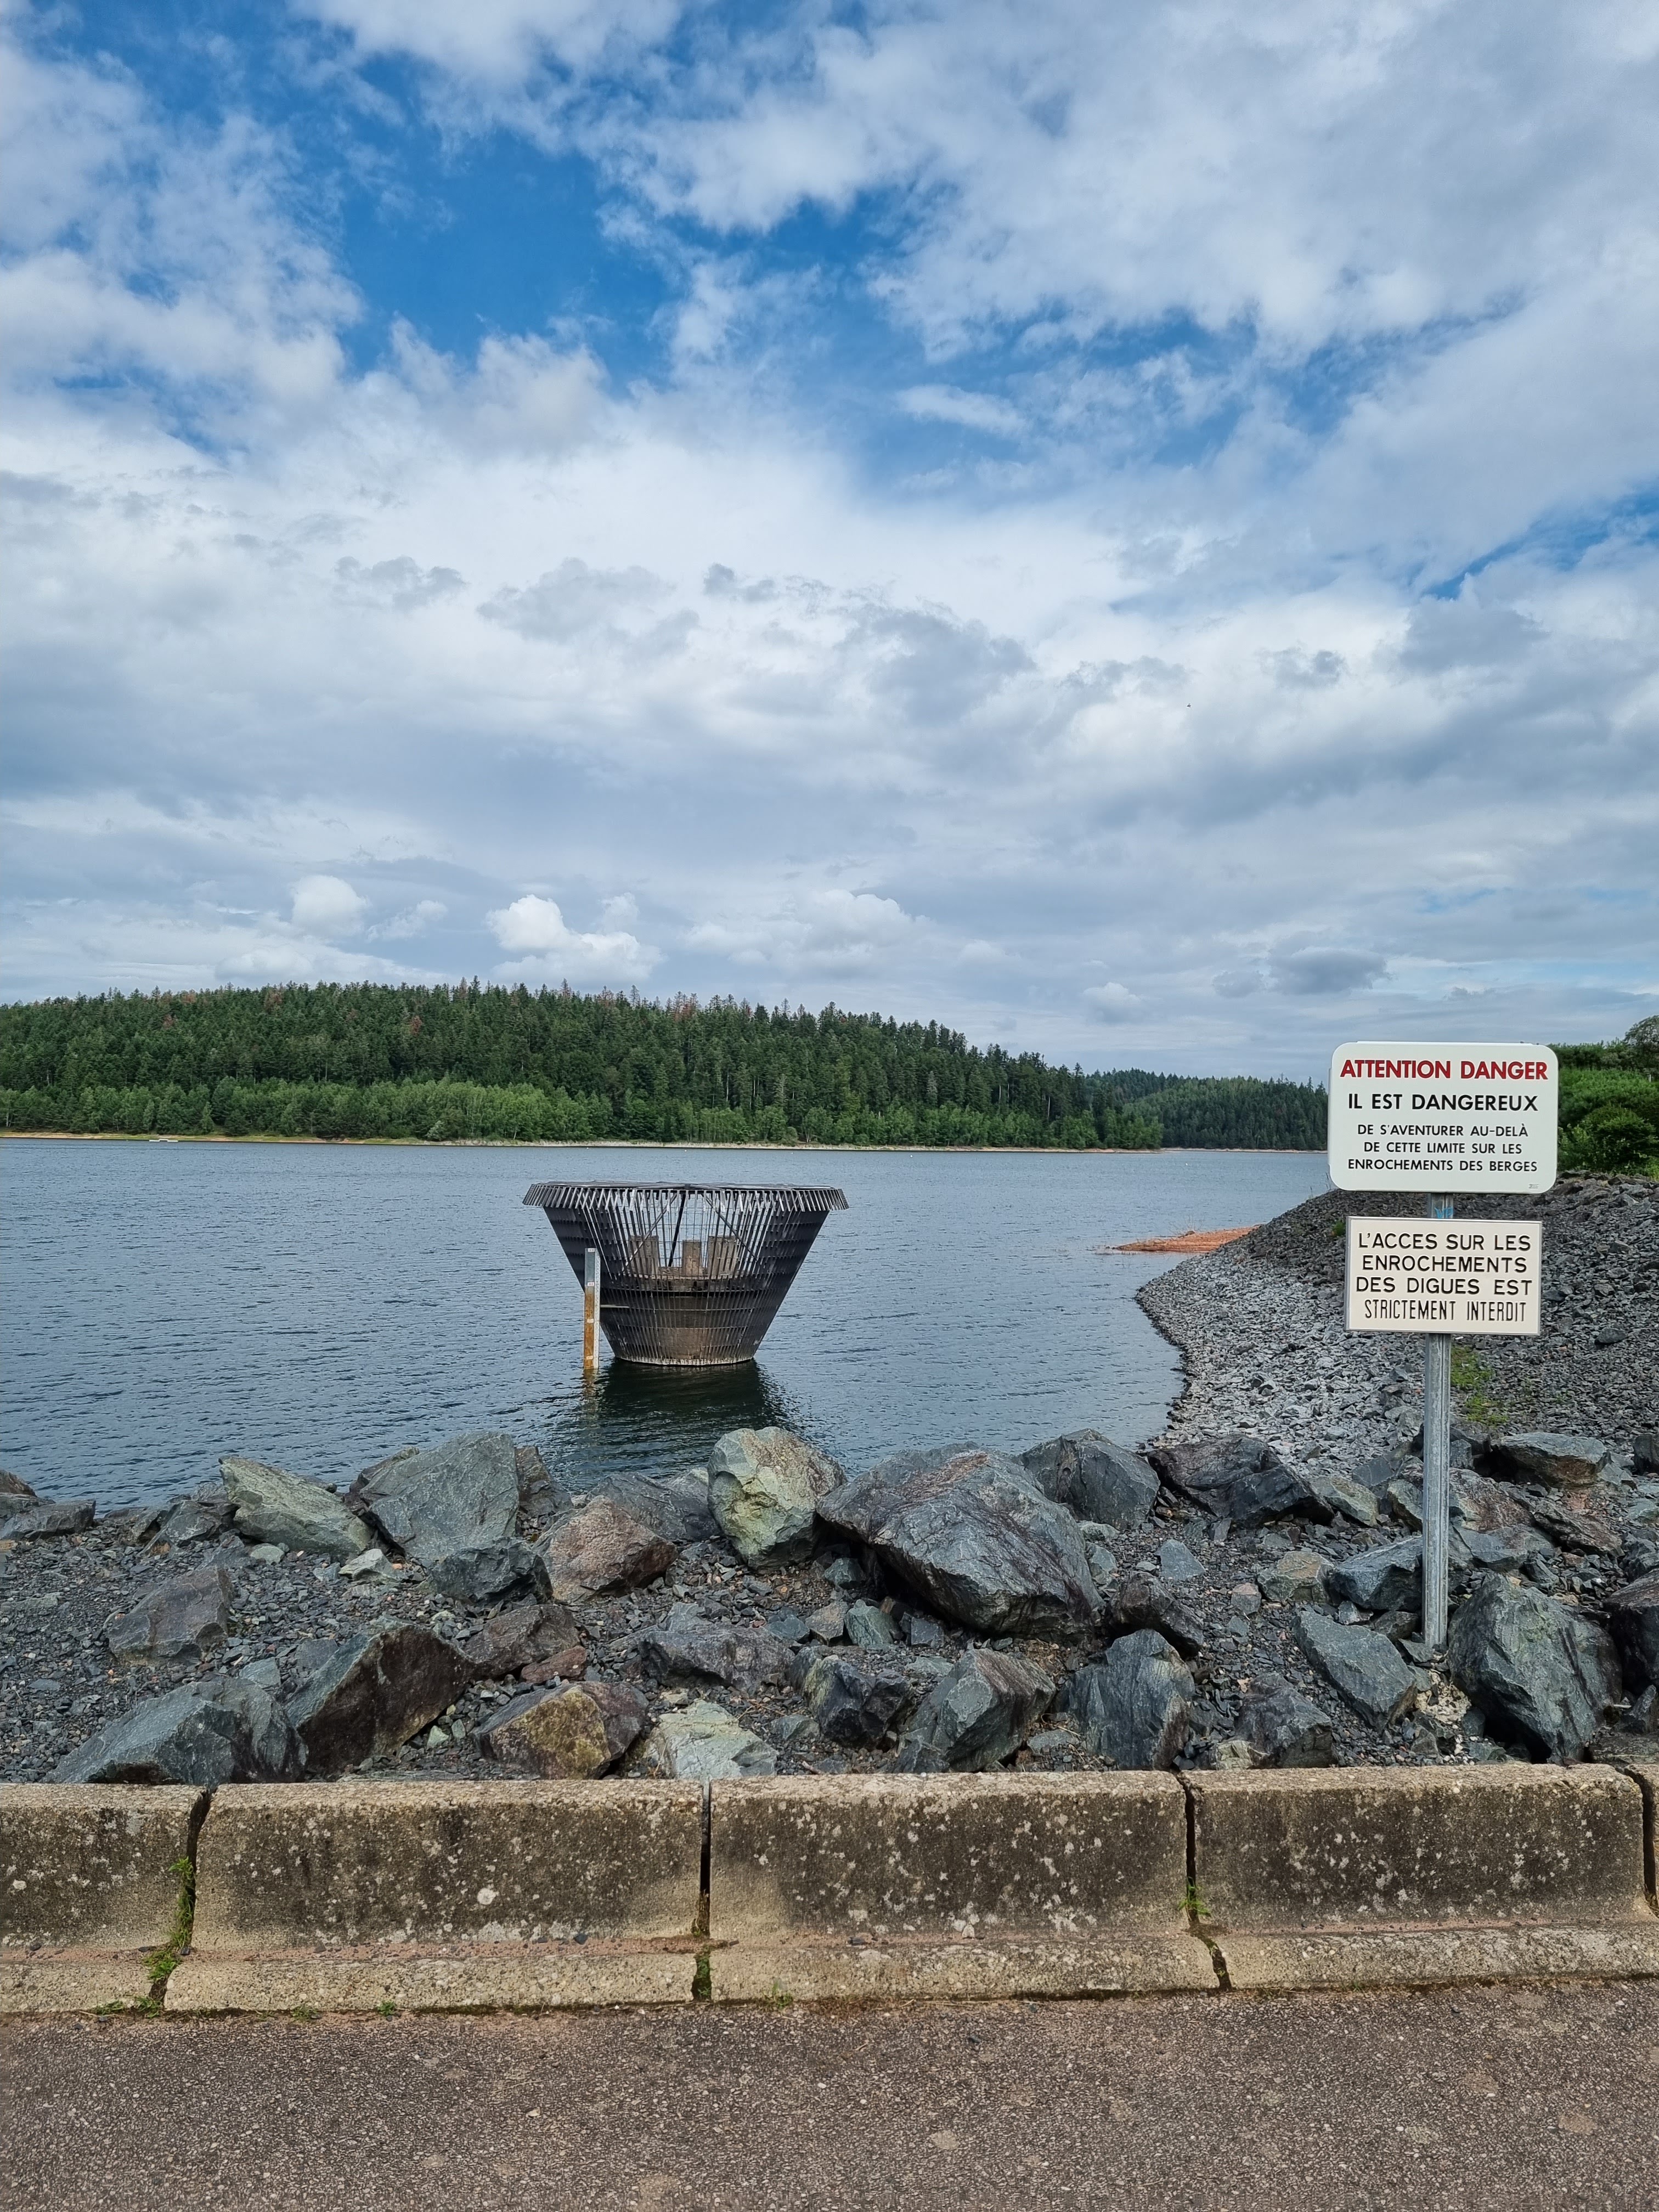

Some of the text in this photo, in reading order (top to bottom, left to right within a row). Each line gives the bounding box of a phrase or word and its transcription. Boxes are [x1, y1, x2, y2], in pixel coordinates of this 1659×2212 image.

[1340, 1060, 1548, 1080] ATTENTION DANGER
[1349, 1094, 1538, 1111] IL EST DANGEREUX
[1358, 1124, 1528, 1136] DE S'AVENTURER AU-DELÀ
[1364, 1142, 1521, 1154] DE CETTE LIMITE SUR LES
[1348, 1159, 1537, 1171] ENROCHEMENTS DES BERGES
[1359, 1233, 1530, 1251] L'ACCES SUR LES
[1363, 1255, 1526, 1273] ENROCHEMENTS
[1357, 1277, 1532, 1295] DES DIGUES EST
[1365, 1300, 1526, 1321] STRICTEMENT INTERDIT
